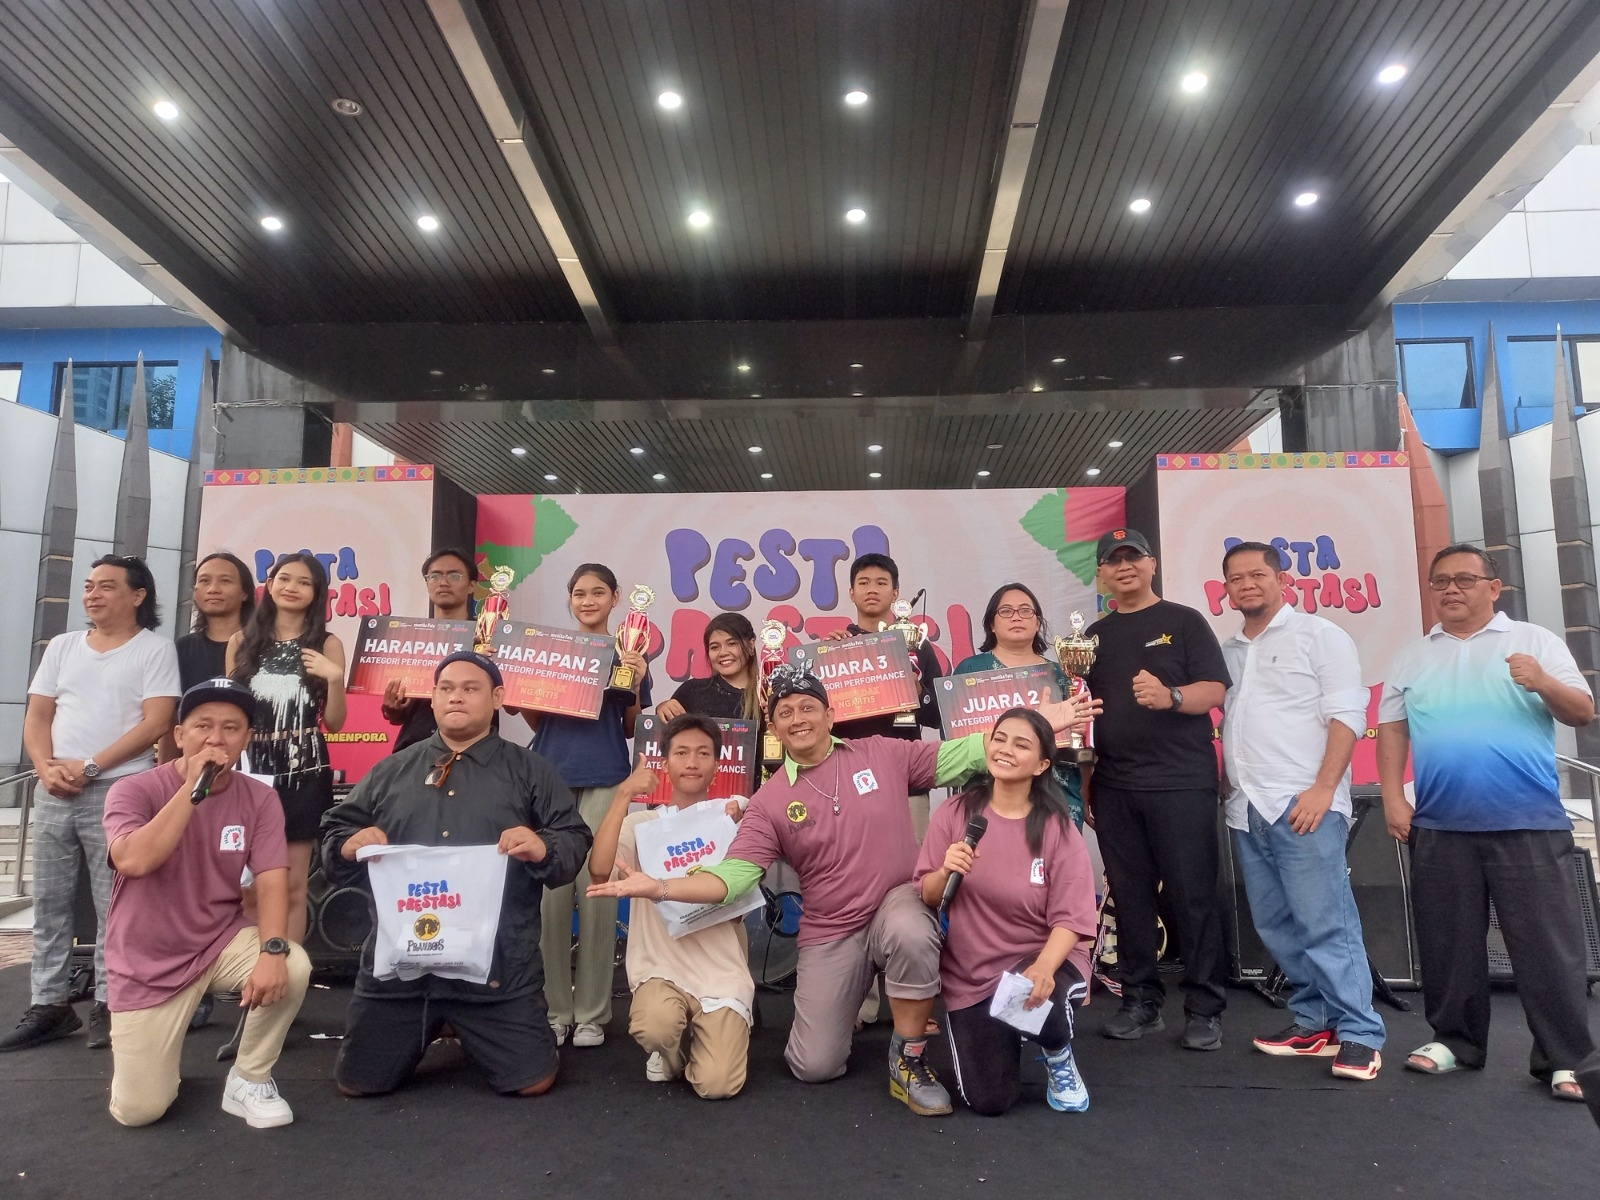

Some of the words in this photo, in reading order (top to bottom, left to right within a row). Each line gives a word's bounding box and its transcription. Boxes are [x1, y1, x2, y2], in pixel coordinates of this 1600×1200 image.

[1223, 535, 1341, 577] STA
[1203, 572, 1382, 617] PSTASI
[364, 638, 449, 657] HARAPAN
[360, 656, 401, 666] KATEGORI
[497, 644, 586, 671] HARAPAN
[588, 658, 601, 674] 2
[818, 658, 875, 681] JUARA
[876, 655, 888, 670] 3
[535, 670, 600, 686] PERFORMANCE
[844, 670, 906, 690] PERFORMANCE
[963, 692, 1026, 714] JUARA
[1027, 690, 1040, 705] 2
[951, 716, 993, 729] KATEGORI
[323, 732, 388, 743] EMENPORA
[736, 745, 744, 761] 1
[663, 841, 716, 872] PRESTASI
[667, 837, 705, 857] PESTA
[408, 880, 449, 897] PESTA
[397, 893, 462, 913] PRESTASI
